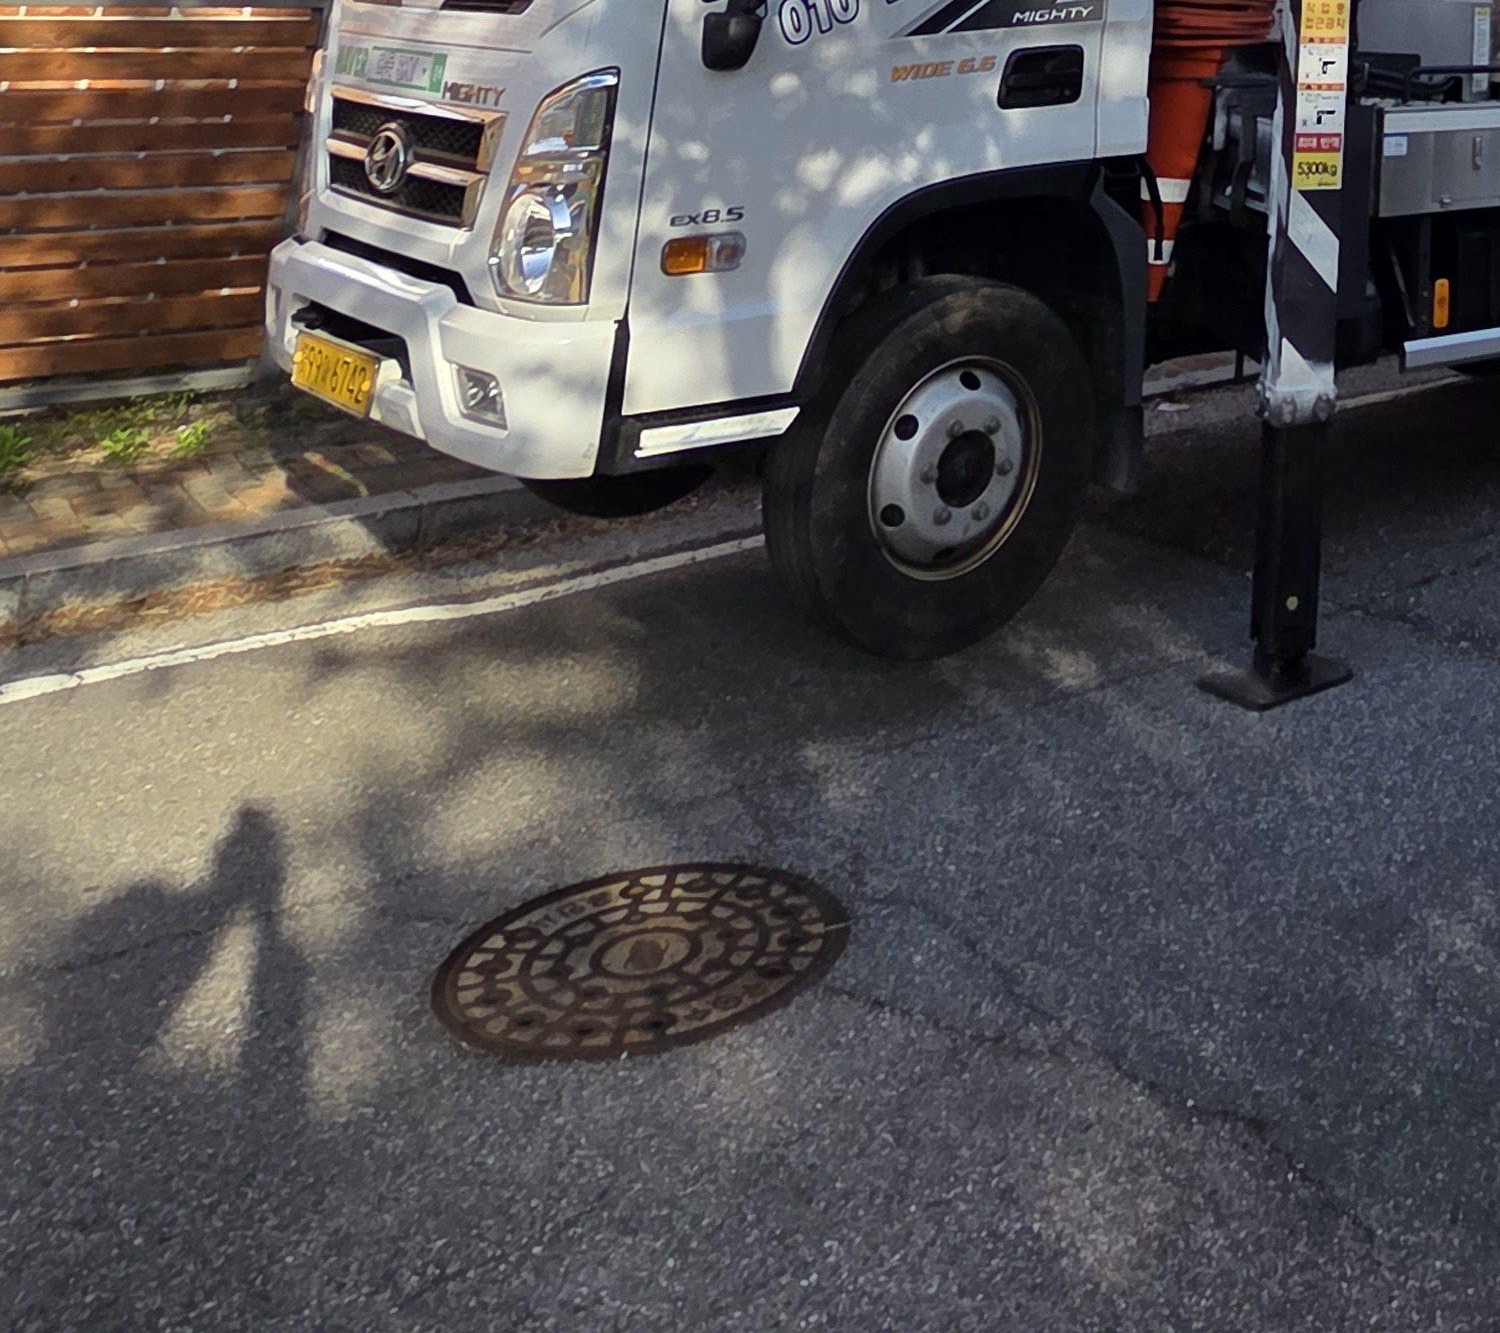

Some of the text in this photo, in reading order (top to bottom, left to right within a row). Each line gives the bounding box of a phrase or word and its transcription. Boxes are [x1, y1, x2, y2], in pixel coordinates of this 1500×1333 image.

[1012, 5, 1095, 24] MIGHTY
[891, 55, 997, 82] WIDE 6.6
